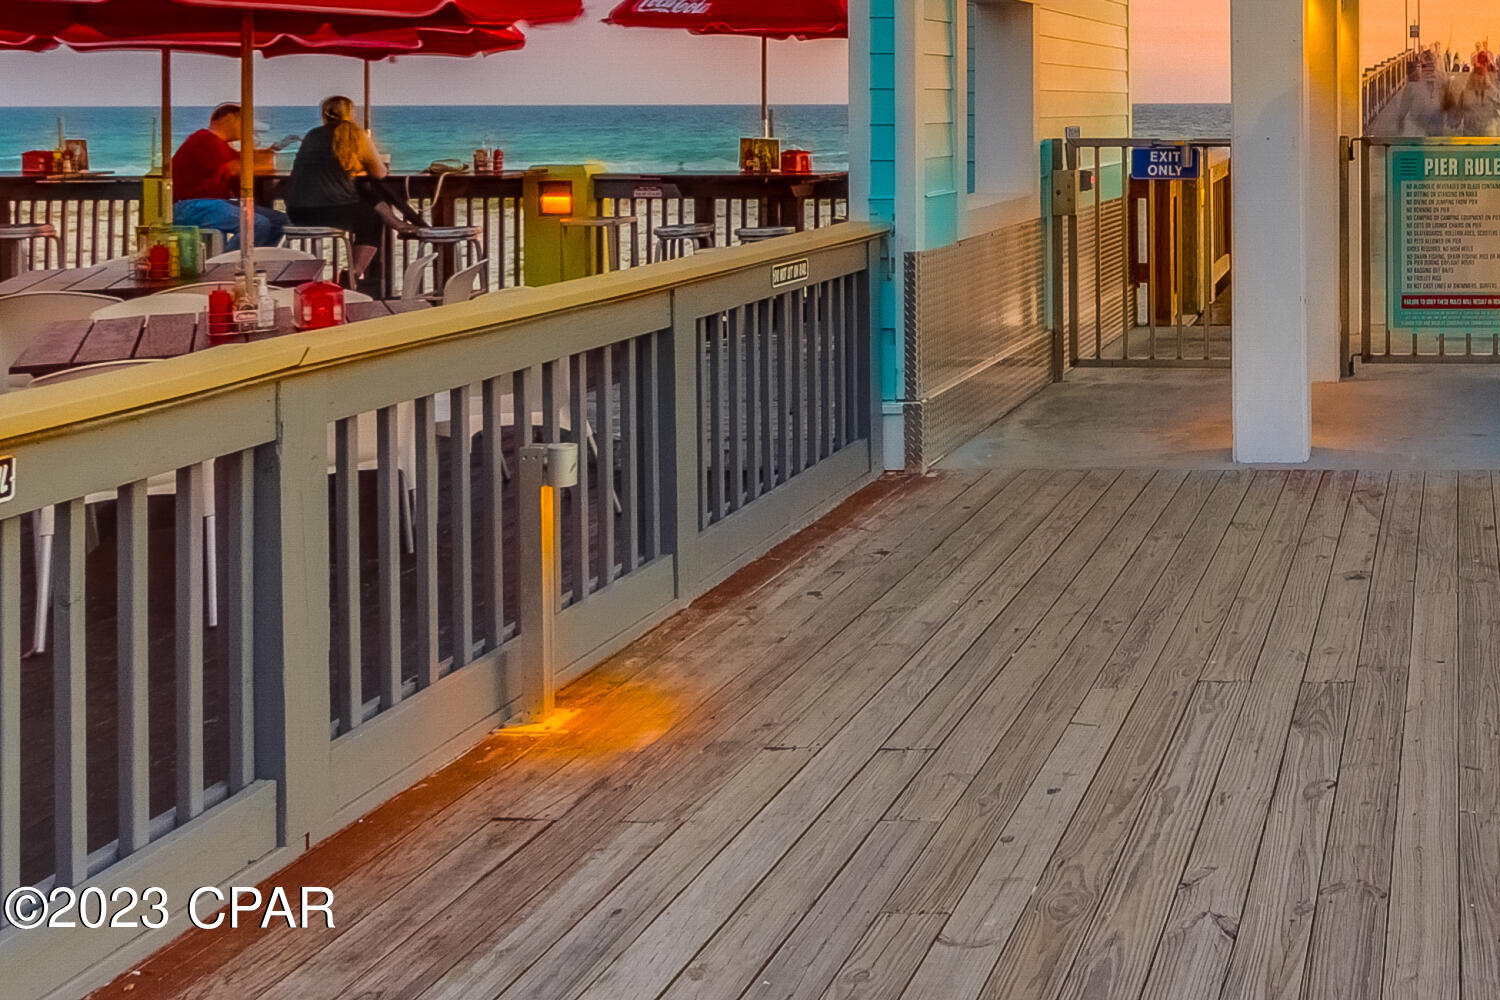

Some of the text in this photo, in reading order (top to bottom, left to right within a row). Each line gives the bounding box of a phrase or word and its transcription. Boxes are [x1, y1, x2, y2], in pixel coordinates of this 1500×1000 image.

[1150, 151, 1181, 163] EXIT
[1147, 164, 1183, 177] ONLY
[1424, 158, 1459, 176] PIER
